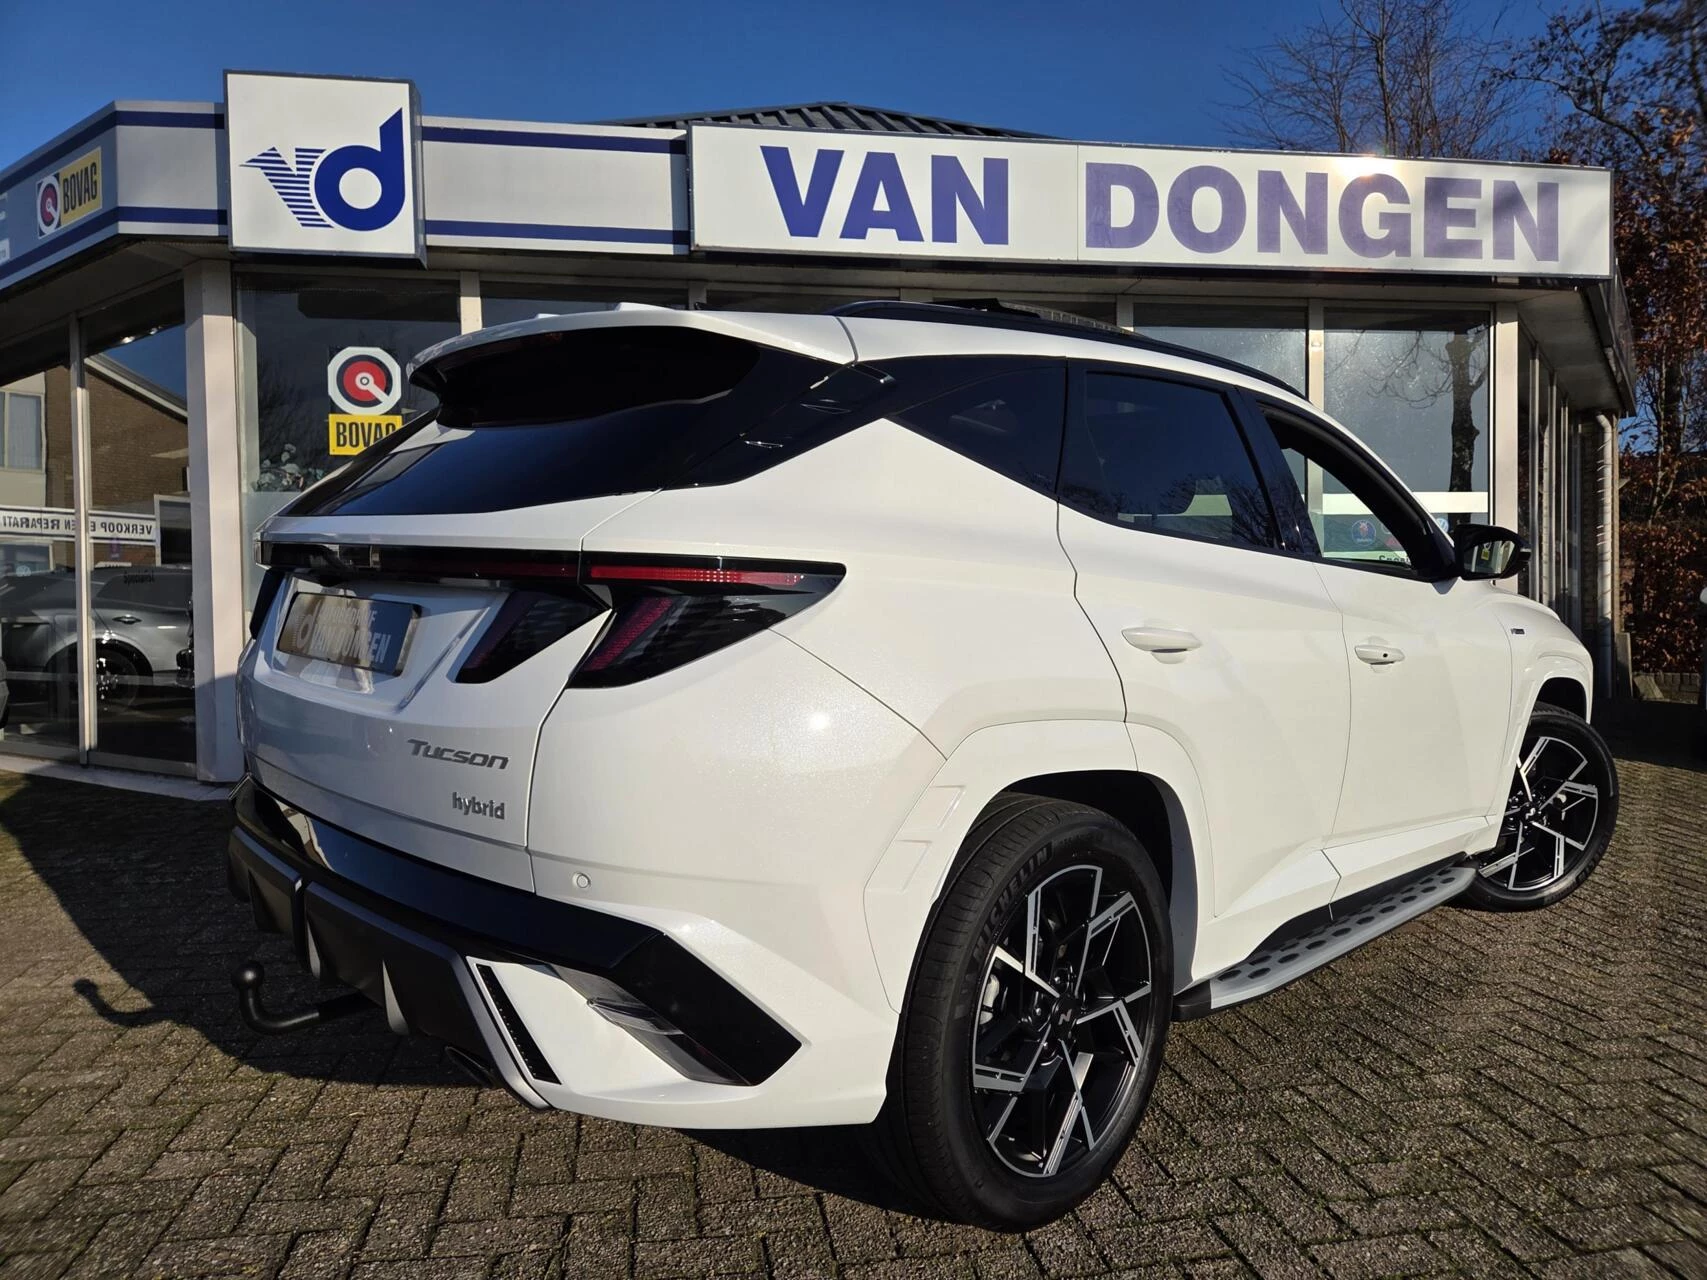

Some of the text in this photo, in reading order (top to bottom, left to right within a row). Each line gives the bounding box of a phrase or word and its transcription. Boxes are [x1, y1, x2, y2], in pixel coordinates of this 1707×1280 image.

[62, 162, 98, 214] BOVAG
[759, 145, 1560, 263] VAN DONGEN
[452, 792, 506, 820] hybrid
